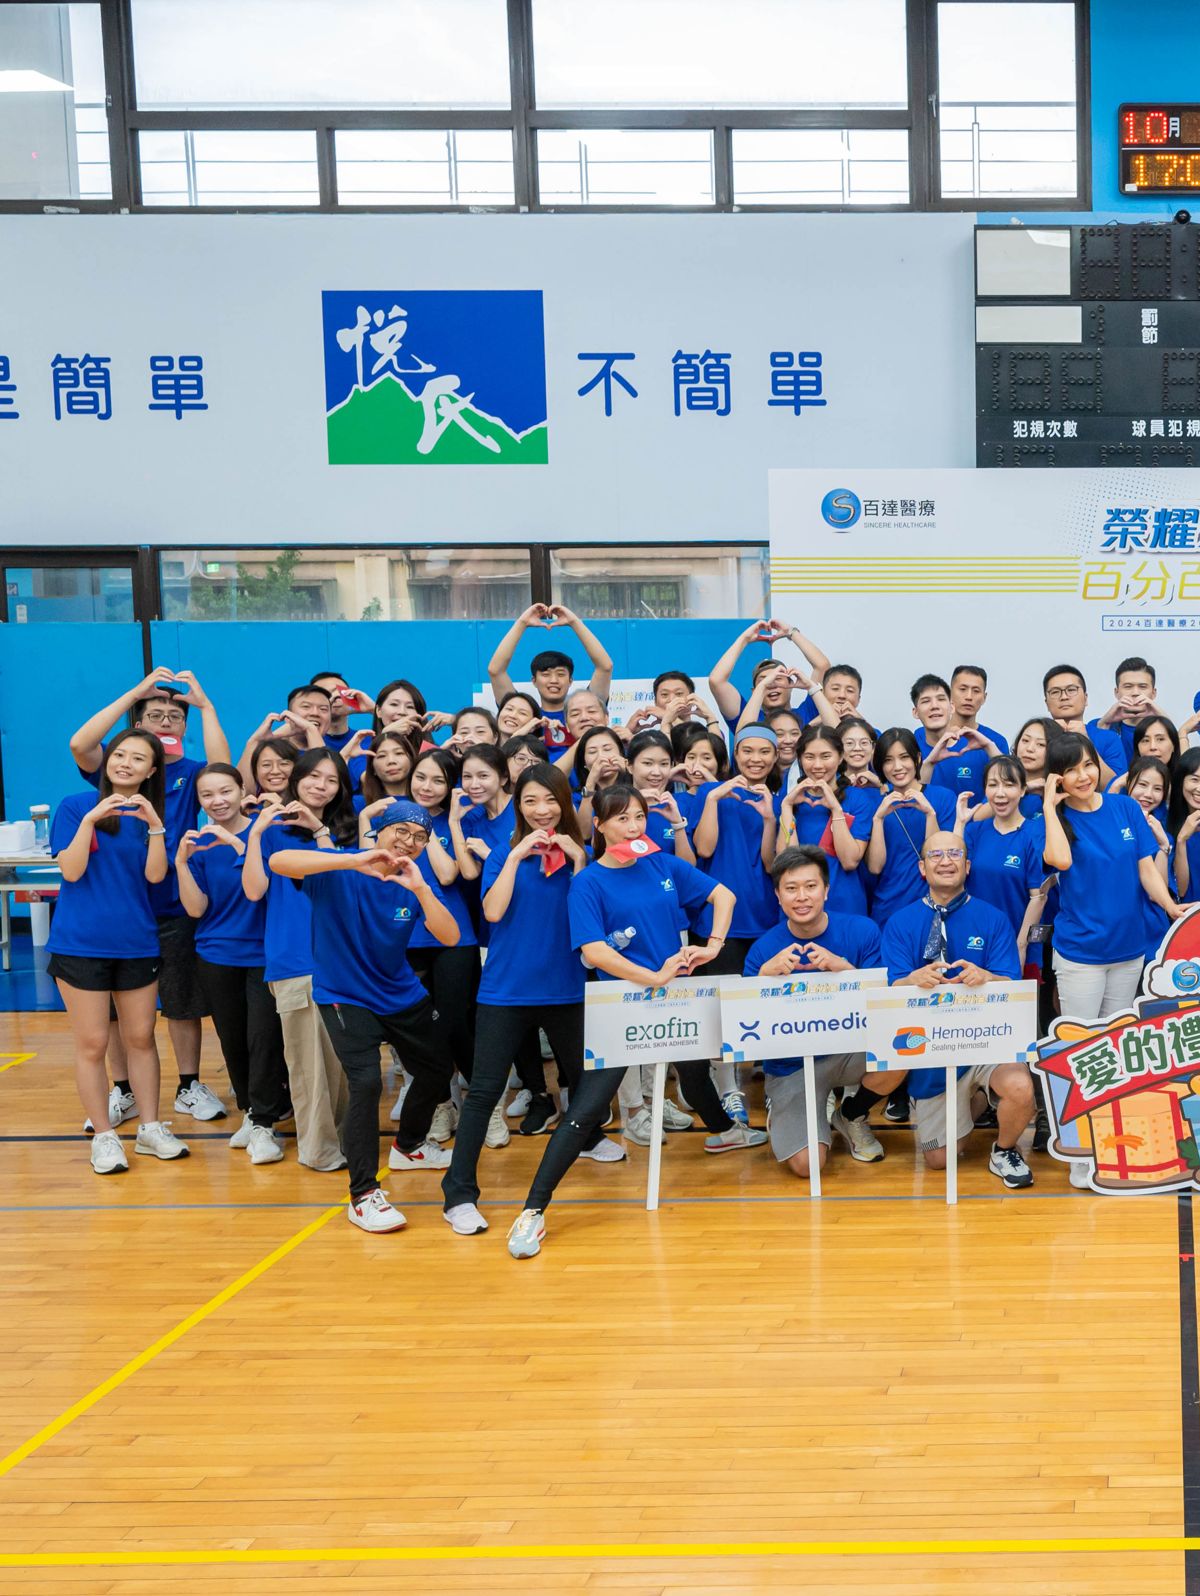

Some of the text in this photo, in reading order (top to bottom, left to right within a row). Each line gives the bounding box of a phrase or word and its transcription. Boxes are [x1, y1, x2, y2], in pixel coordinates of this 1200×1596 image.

[577, 349, 827, 417] 不簡單
[1013, 419, 1078, 438] 犯規次數
[863, 499, 936, 517] 百達醫療
[625, 1016, 699, 1042] exofin
[932, 1022, 1013, 1042] Hemopatch
[626, 1043, 652, 1051] TOPICAL
[669, 1039, 699, 1047] ADHESIVE
[931, 1041, 989, 1052] Sealing Hemostat
